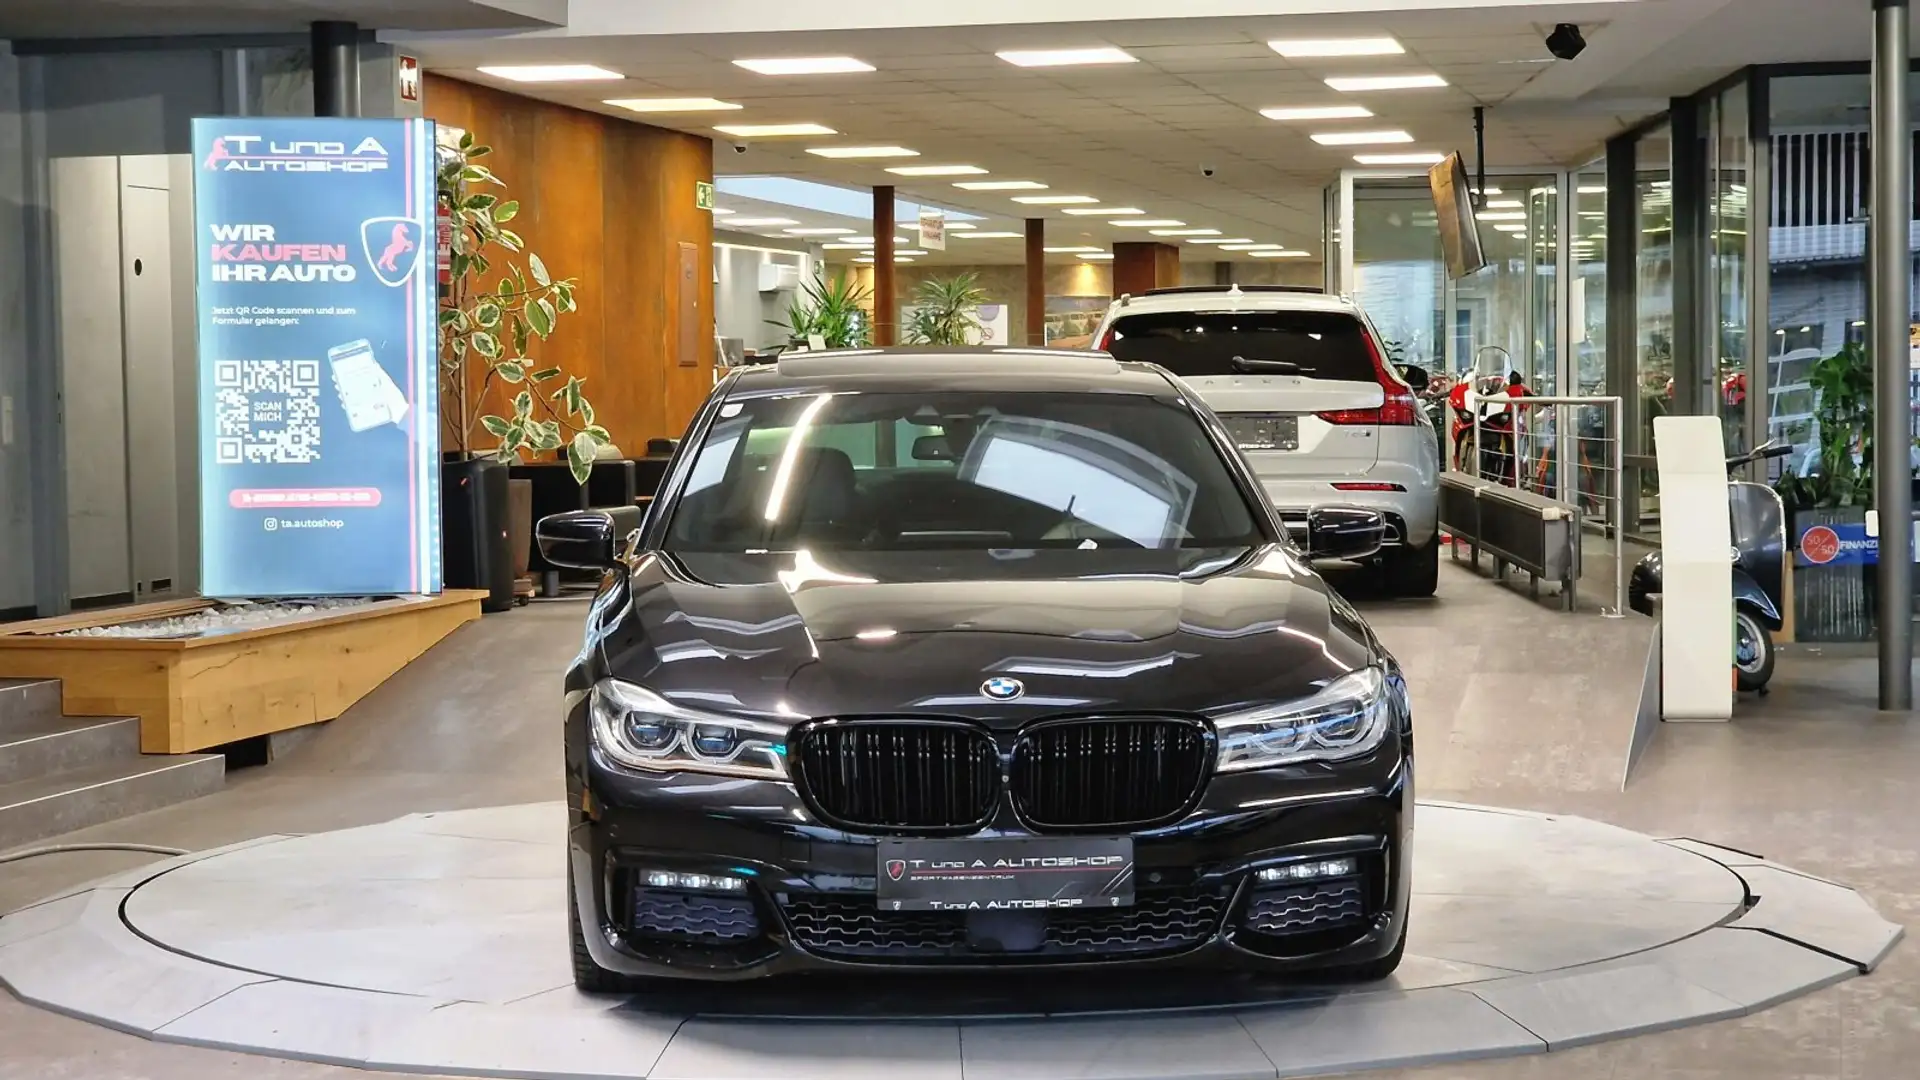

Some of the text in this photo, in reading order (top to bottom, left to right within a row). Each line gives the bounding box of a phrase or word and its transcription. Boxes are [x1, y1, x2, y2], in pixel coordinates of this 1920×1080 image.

[224, 135, 261, 153] T
[352, 136, 388, 155] A
[224, 160, 388, 172] AUTOSHOP
[209, 224, 275, 241] WIR
[211, 244, 346, 262] KAUFEN
[211, 264, 356, 282] IHR AUTO
[211, 306, 356, 316] Jetzt QR Code scannen und zum
[212, 317, 300, 327] Formular gelangen:
[253, 401, 282, 411] SCAN
[253, 411, 282, 421] MICH
[281, 517, 344, 529] ta.autoshop
[1839, 540, 1879, 550] FINANZI
[910, 859, 926, 868] T
[971, 859, 987, 868] A
[993, 856, 1123, 868] AUTOSHOP
[930, 901, 942, 909] T
[968, 901, 981, 909] A
[986, 898, 1083, 909] AUTOSHOP
